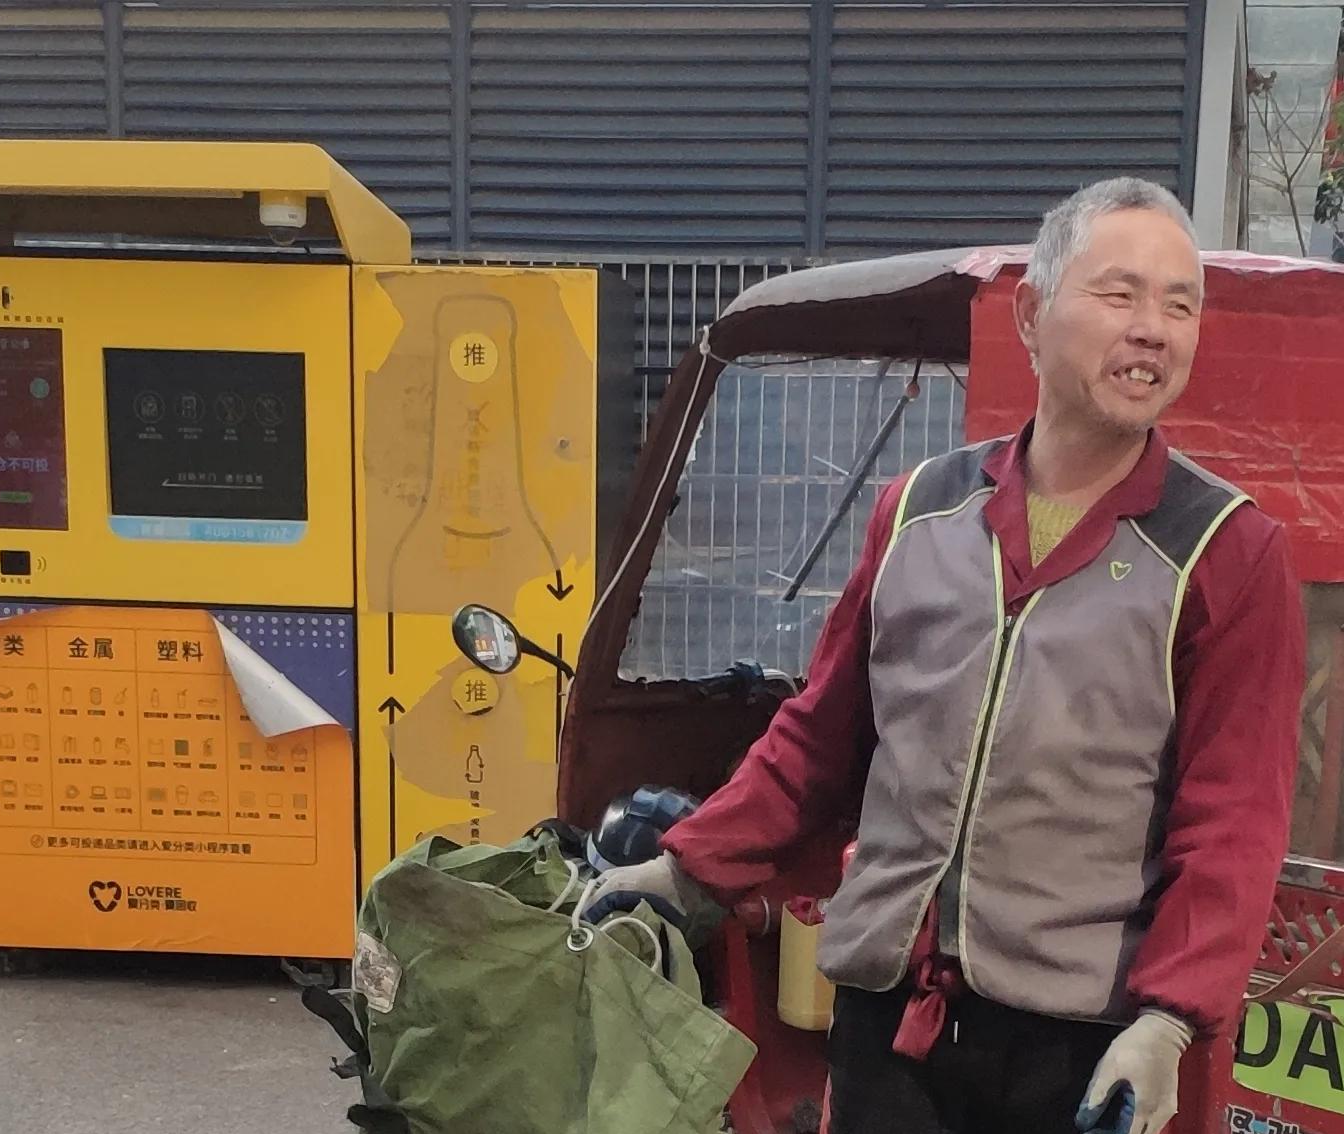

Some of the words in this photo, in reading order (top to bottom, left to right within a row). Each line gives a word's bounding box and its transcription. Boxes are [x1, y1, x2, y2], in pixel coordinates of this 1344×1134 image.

[463, 342, 485, 366] 推
[68, 637, 114, 660] 金属
[157, 640, 204, 663] 塑料
[465, 679, 487, 702] 推
[127, 886, 182, 899] LOVERE
